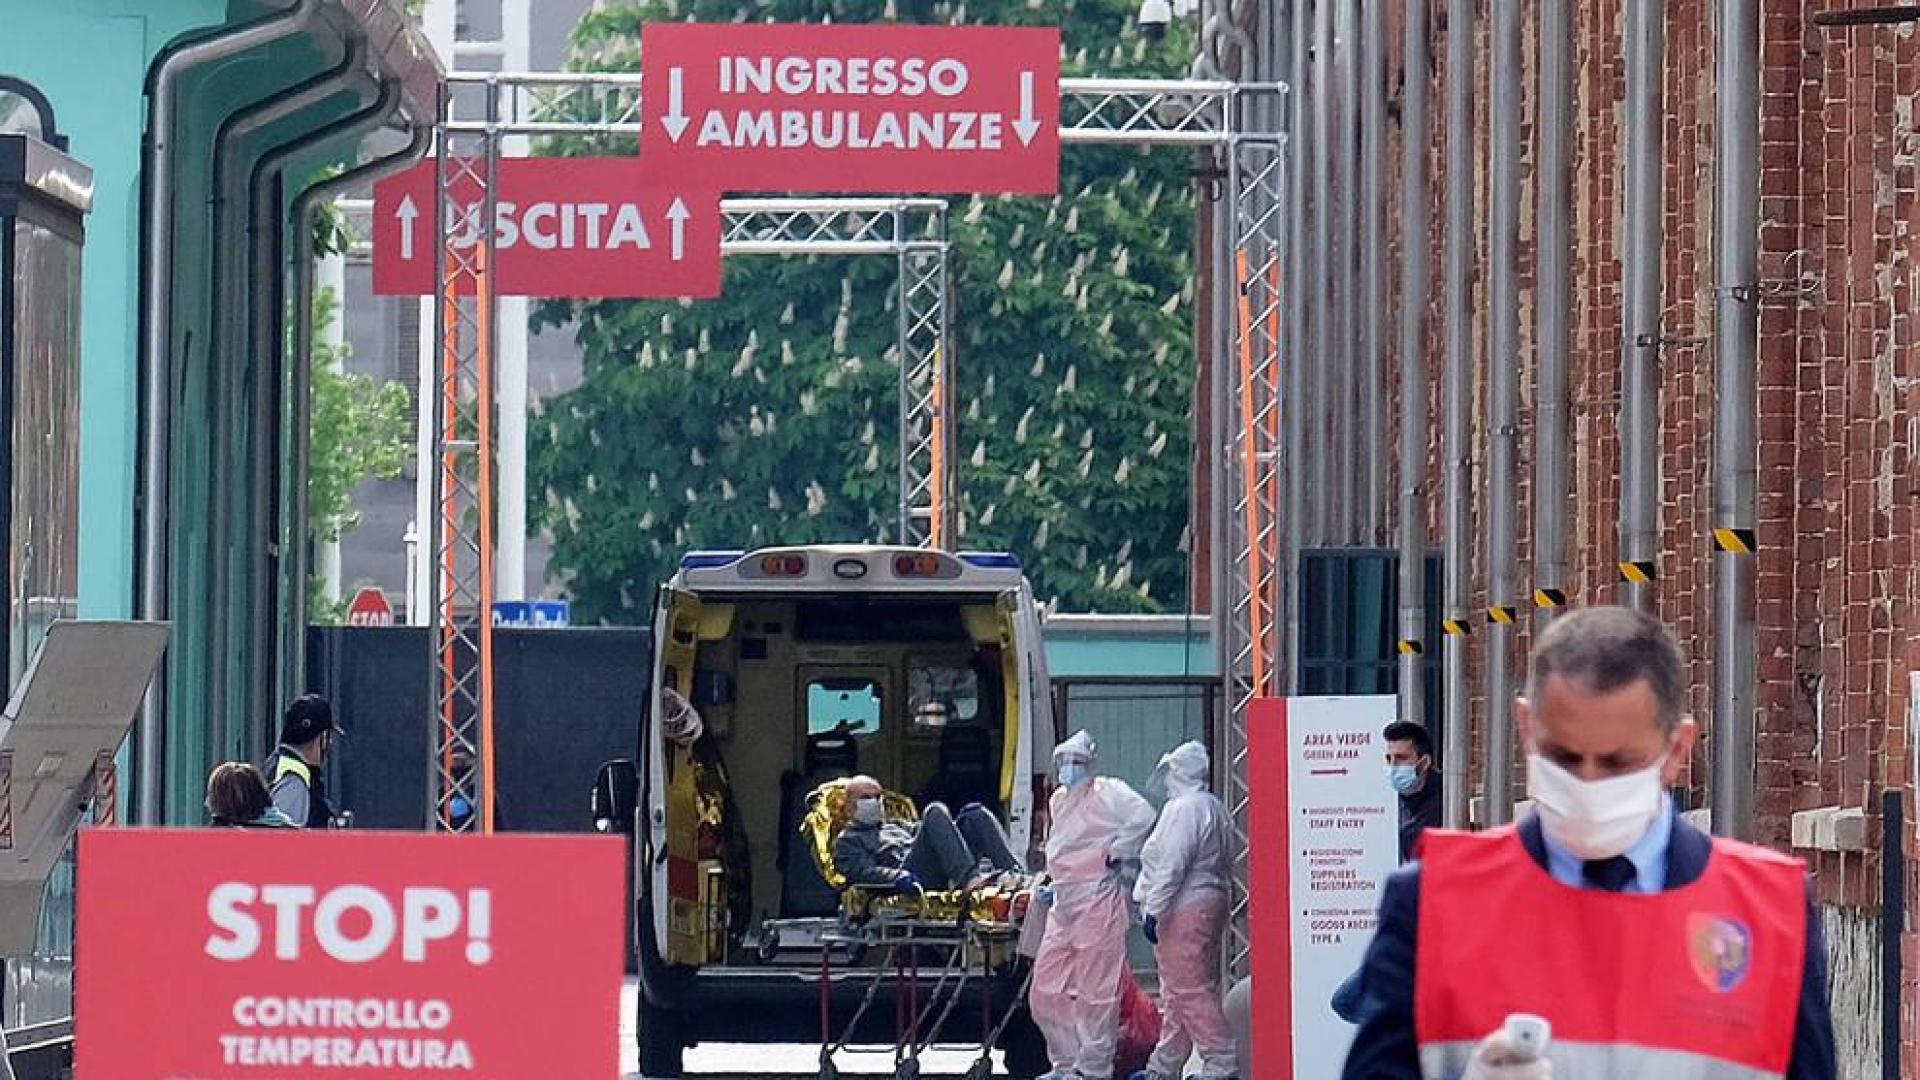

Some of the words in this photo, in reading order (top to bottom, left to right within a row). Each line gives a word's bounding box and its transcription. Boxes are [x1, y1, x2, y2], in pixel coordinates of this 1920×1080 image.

[718, 56, 969, 96] INGRESSO
[697, 110, 1002, 150] AMBULANZE
[444, 201, 651, 250] USCITA
[1303, 734, 1333, 746] AREA
[1336, 732, 1370, 745] VERDE
[1303, 749, 1335, 760] GREEN
[1336, 749, 1360, 759] AREA
[1310, 819, 1333, 829] STAFF
[1337, 818, 1364, 829] ENTRY
[1310, 869, 1356, 879] SUPPLIERS
[1310, 880, 1376, 891] REGISTRATION
[204, 881, 493, 966] STOP!
[1310, 933, 1332, 944] TYPE
[1334, 933, 1342, 943] A
[232, 996, 451, 1030] CONTROLLO
[220, 1034, 473, 1069] TEMPERATURA
